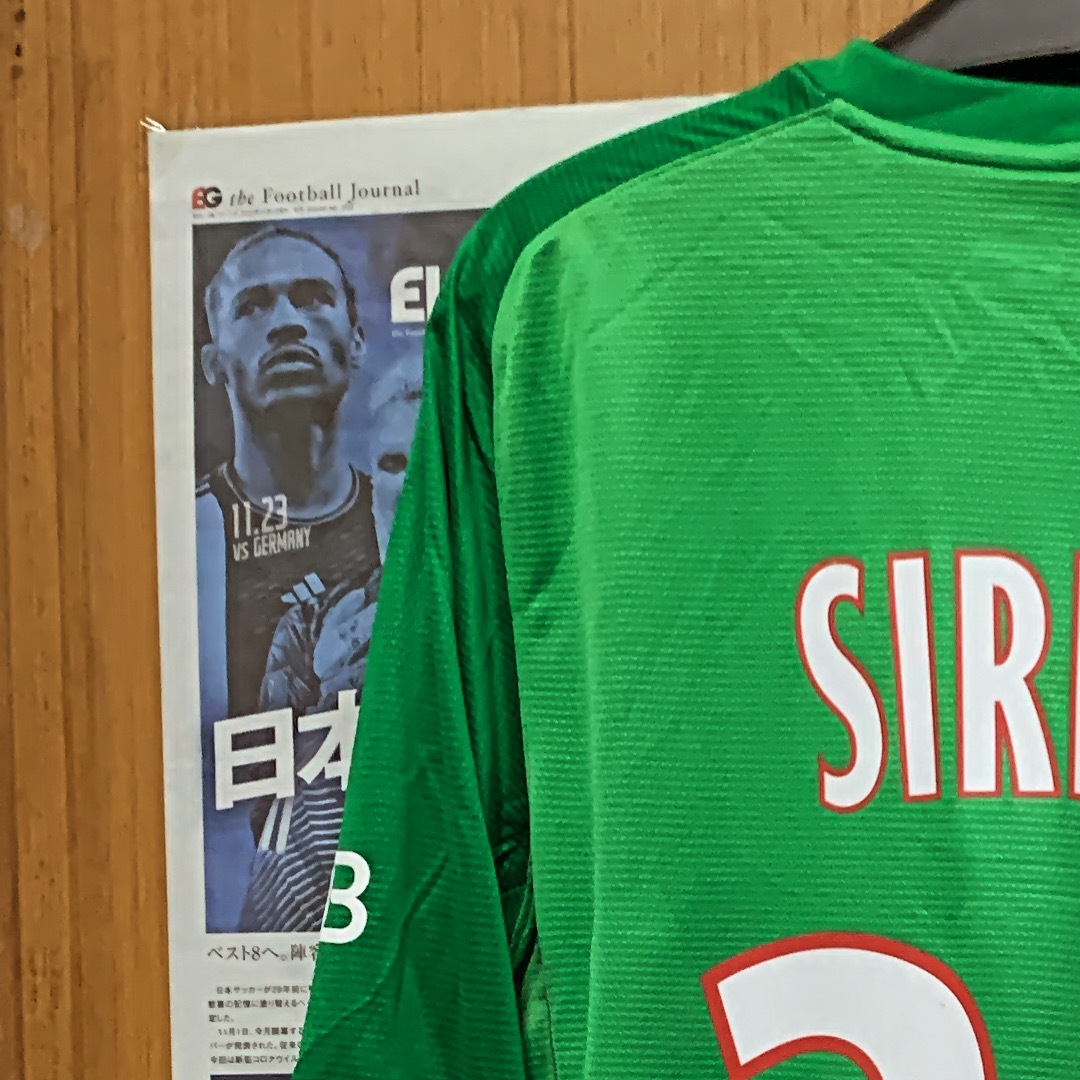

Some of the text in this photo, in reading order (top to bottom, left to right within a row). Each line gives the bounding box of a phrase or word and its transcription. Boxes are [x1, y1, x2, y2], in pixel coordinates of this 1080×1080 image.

[230, 188, 254, 207] the
[263, 182, 342, 204] Football
[347, 178, 421, 205] Journal
[232, 493, 288, 539] 11.23
[233, 526, 312, 562] VS GERMANY
